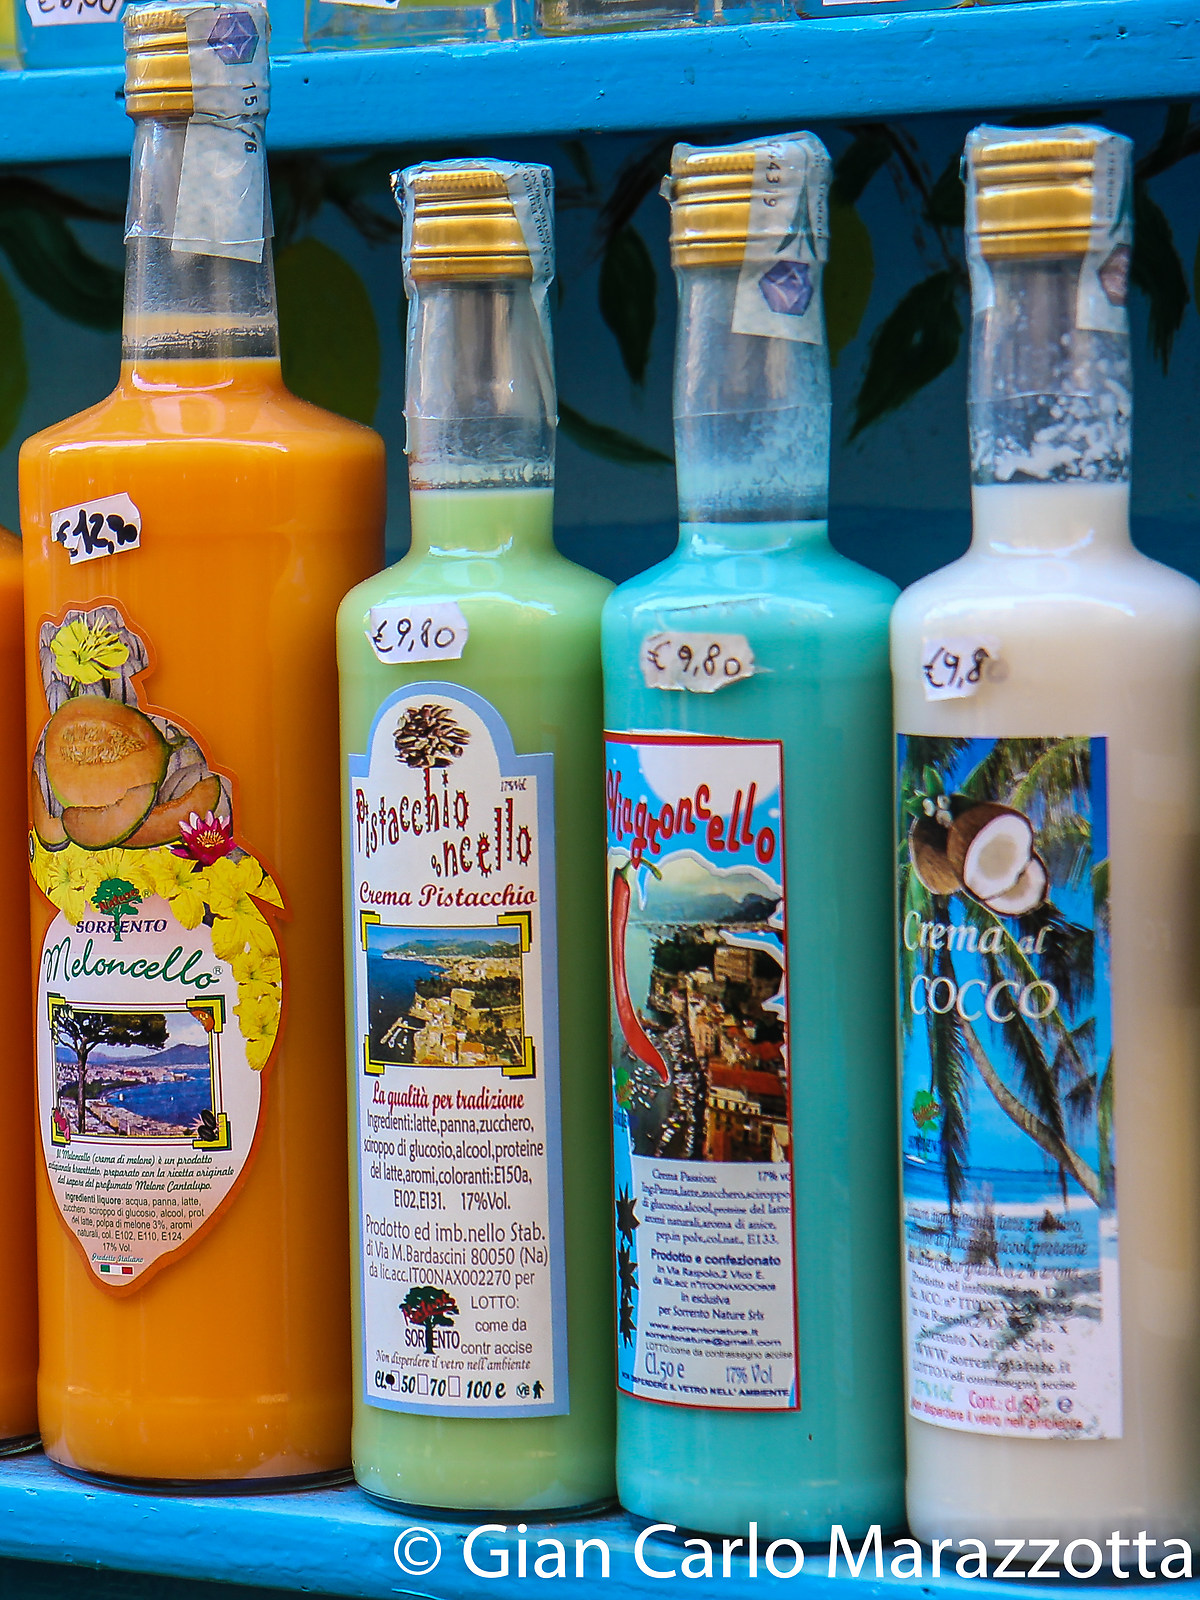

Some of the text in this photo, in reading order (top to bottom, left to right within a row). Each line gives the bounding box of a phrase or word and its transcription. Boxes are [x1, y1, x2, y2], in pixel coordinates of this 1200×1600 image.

[373, 617, 456, 653] €9,80
[646, 640, 742, 678] €9,80
[355, 768, 469, 859] Pistacchio
[359, 881, 537, 908] Crema Pistacchio
[903, 910, 1006, 955] Crema
[44, 936, 220, 990] Meloncello
[910, 974, 1060, 1024] COCCO
[372, 1080, 525, 1116] La qualità per tradizione
[364, 1135, 395, 1160] sciroppo
[397, 1138, 407, 1157] di
[117, 1154, 125, 1163] di
[176, 1155, 212, 1168] prodotto
[370, 1161, 382, 1179] del
[103, 1168, 140, 1180] preparato
[157, 1168, 166, 1178] la
[167, 1168, 195, 1178] ricetta
[196, 1166, 234, 1180] originale
[95, 1180, 212, 1193] profumato Melone Cantalupo.
[65, 1192, 201, 1208] Ingredienti acqua, panna, latte,
[750, 1203, 766, 1214] del
[117, 1208, 185, 1219] di glucosio, alcool,
[96, 1219, 193, 1229] polpa di melone aromi
[365, 1214, 411, 1240] Prodotto
[414, 1221, 431, 1241] ed
[511, 1221, 546, 1241] Stab.
[735, 1218, 745, 1229] di
[115, 1230, 184, 1241] E102, E110, E124.
[102, 1242, 117, 1252] 17%
[366, 1239, 374, 1257] di
[375, 1240, 389, 1260] Via
[471, 1248, 515, 1266] 80050
[520, 1245, 548, 1267] (Na)
[651, 1248, 781, 1266] Prodotto e confezionato
[369, 1262, 378, 1278] da
[515, 1272, 535, 1289] per
[471, 1295, 520, 1310] LOTTO:
[658, 1306, 670, 1317] per
[673, 1306, 710, 1319] Sorrento
[712, 1310, 745, 1320] Nature
[475, 1318, 527, 1332] come da
[494, 1341, 533, 1354] accise
[375, 1349, 390, 1364] Non
[391, 1352, 430, 1369] disperdere
[431, 1356, 439, 1370] il
[440, 1358, 464, 1370] vetro
[401, 1375, 506, 1399] 50 70 100 e
[679, 1384, 707, 1395] VETRO
